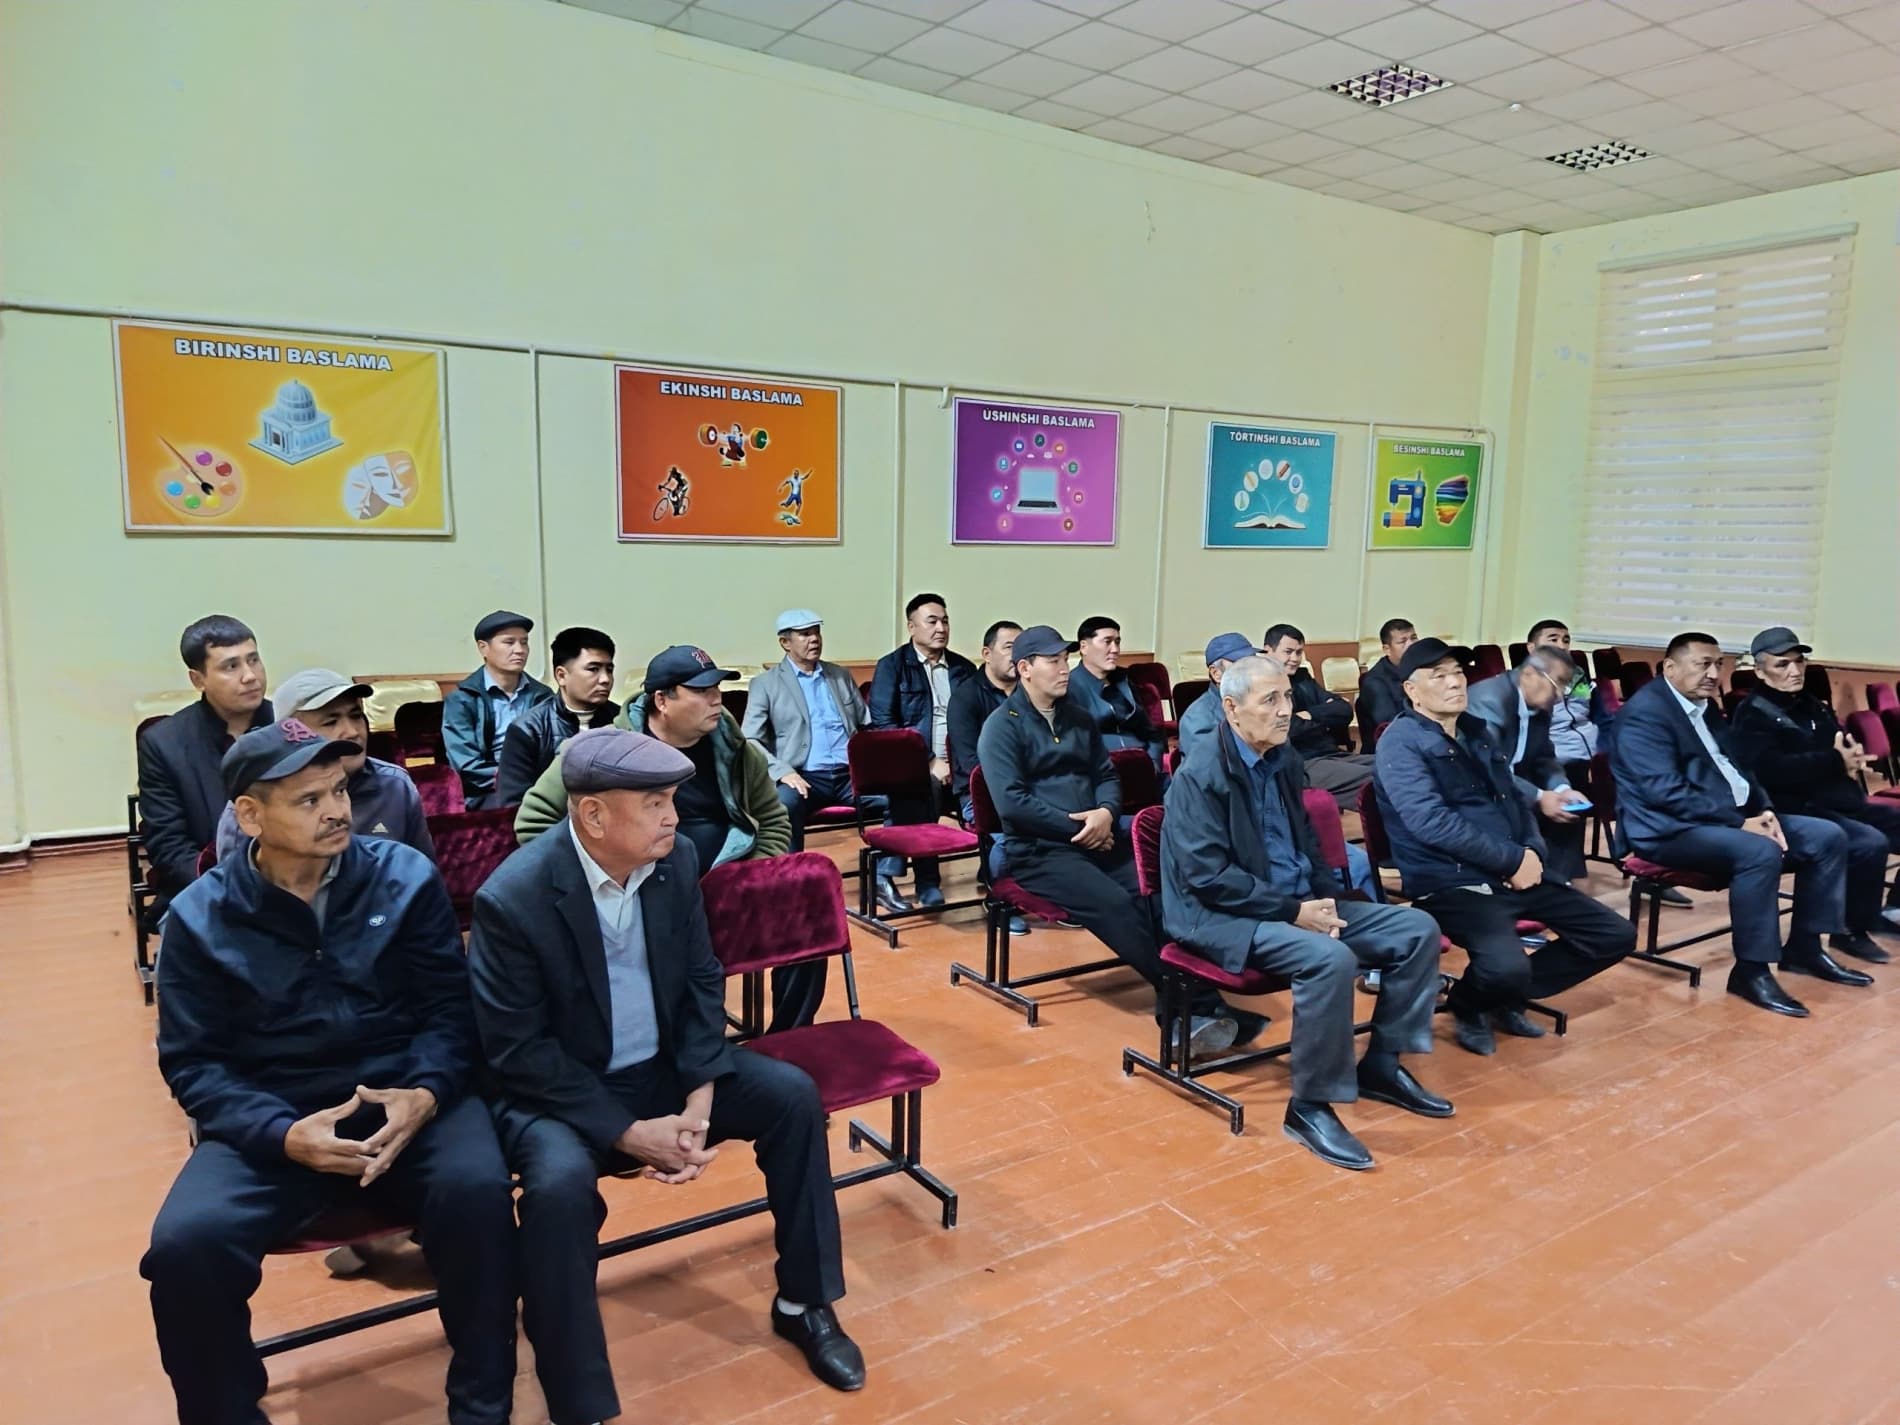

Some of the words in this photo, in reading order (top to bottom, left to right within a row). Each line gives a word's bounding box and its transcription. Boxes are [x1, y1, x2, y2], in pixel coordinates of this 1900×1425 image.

[174, 337, 281, 362] BIRINSHI
[286, 347, 393, 371] BASLAMA
[660, 380, 727, 399] EKINSHI
[730, 387, 803, 406] BASLAMA
[1042, 414, 1095, 428] BASLAMA
[1280, 435, 1321, 447] BASLAMA
[1430, 447, 1465, 457] BASLAMA
